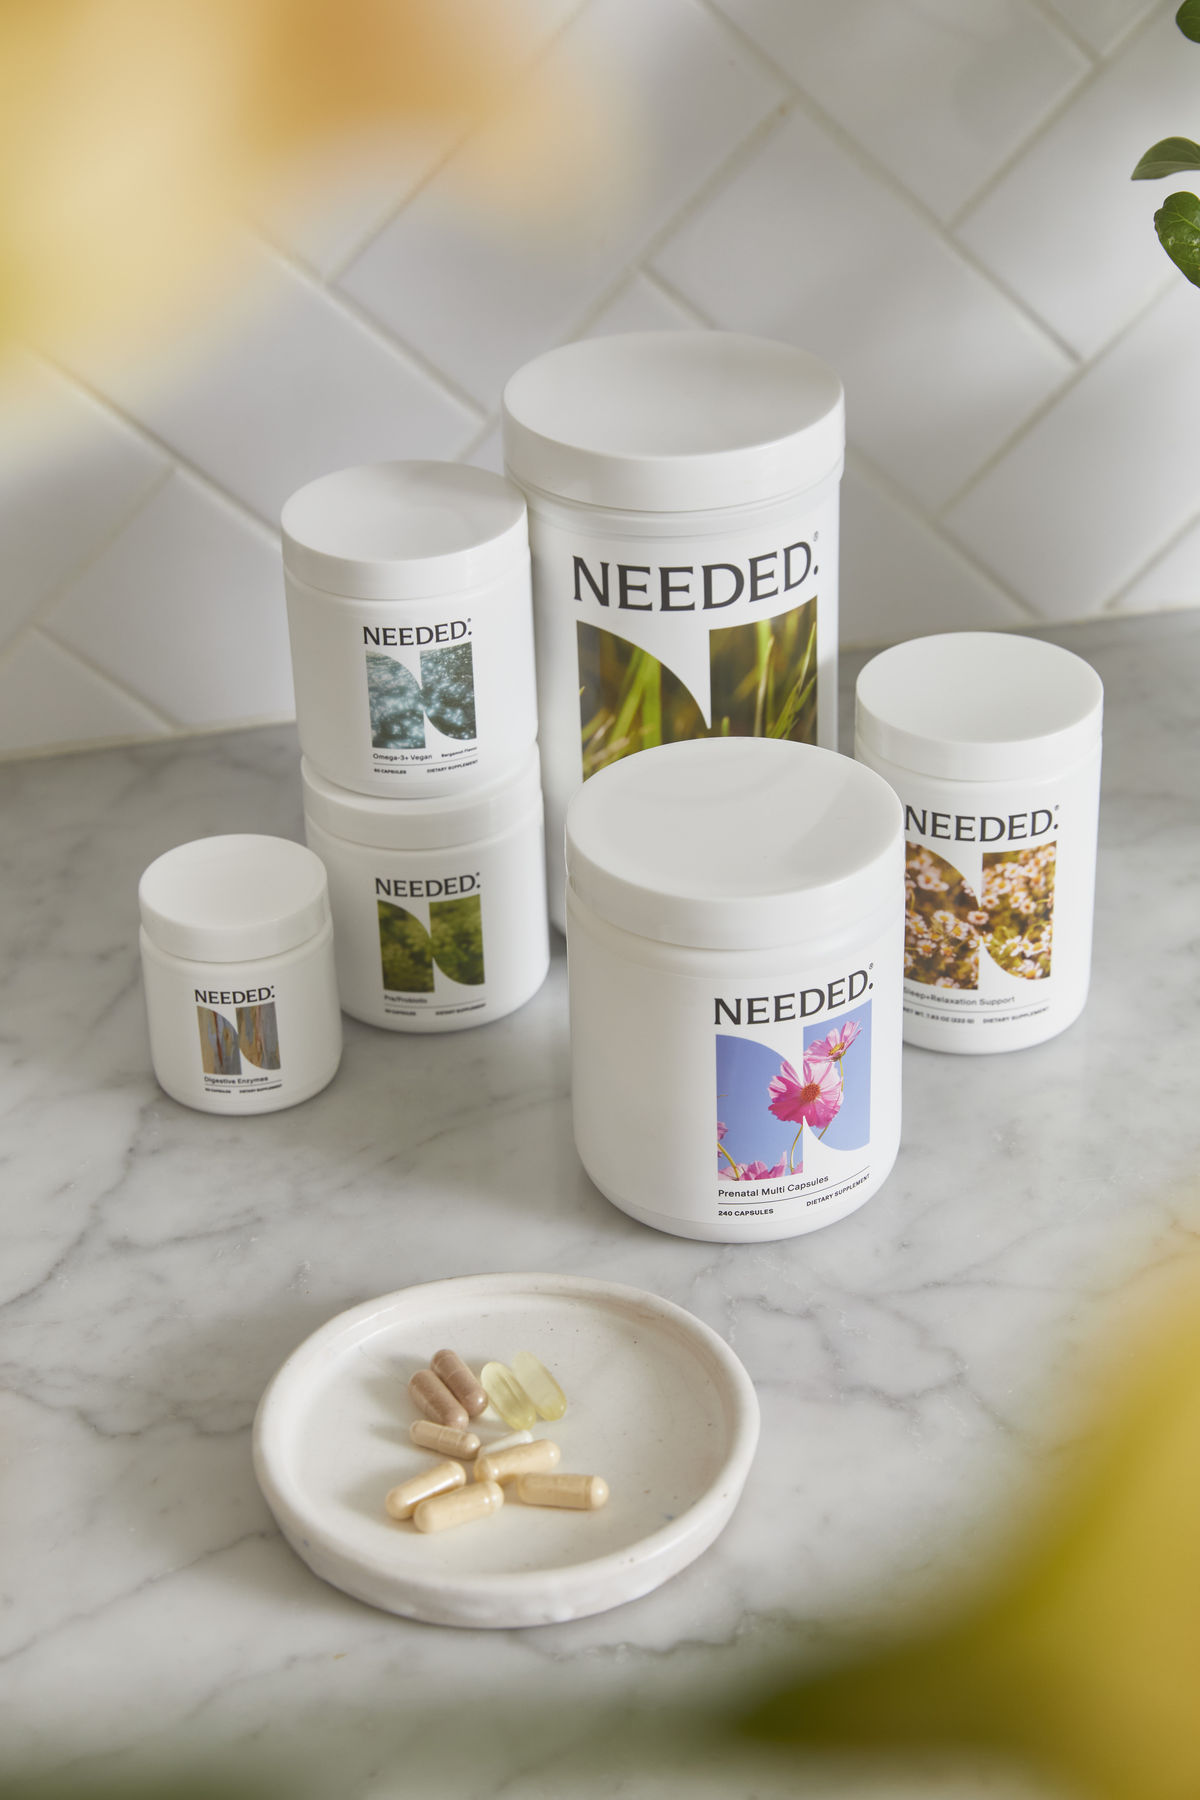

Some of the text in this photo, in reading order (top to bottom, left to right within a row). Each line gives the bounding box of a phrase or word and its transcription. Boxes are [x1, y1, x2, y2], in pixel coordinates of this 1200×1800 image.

[410, 754, 433, 762] Vegan
[979, 996, 1015, 1006] Support
[718, 1175, 829, 1198] Prenatal Multi Capsules
[806, 1173, 870, 1207] DIETARY SUPPLEMENT
[734, 1208, 774, 1217] CAPSULES
